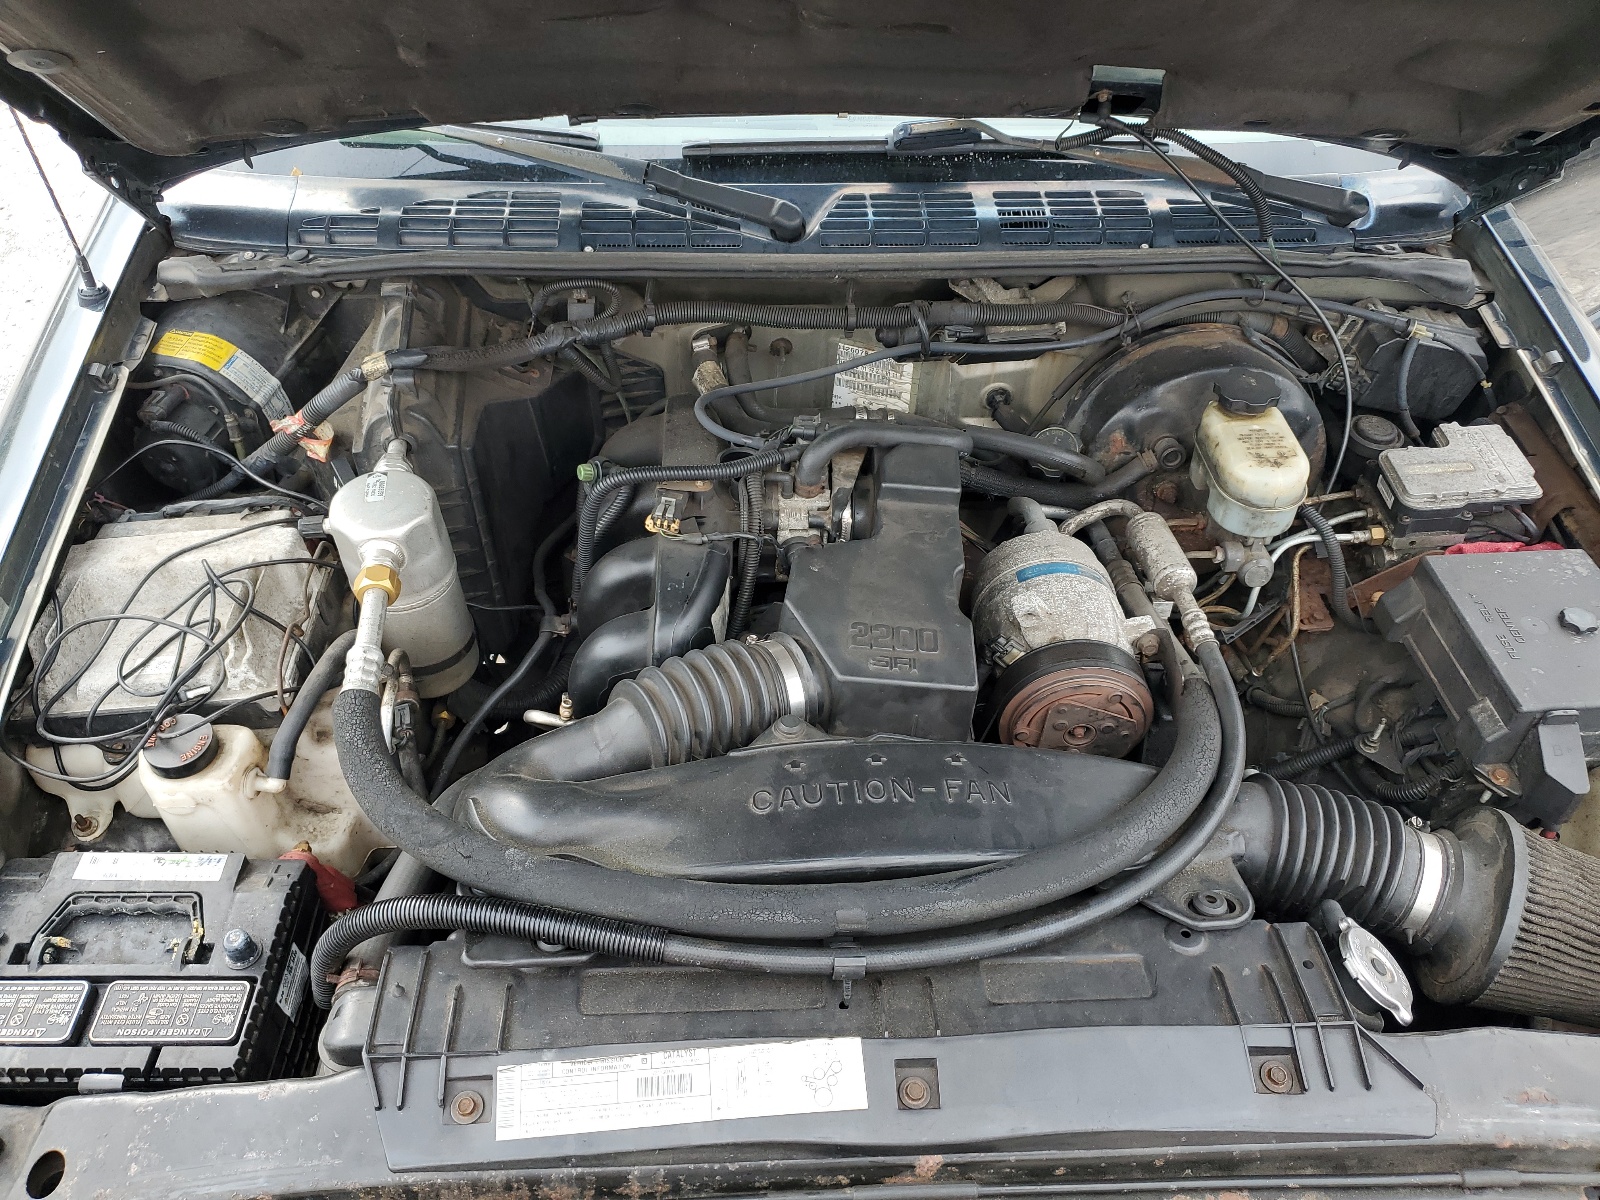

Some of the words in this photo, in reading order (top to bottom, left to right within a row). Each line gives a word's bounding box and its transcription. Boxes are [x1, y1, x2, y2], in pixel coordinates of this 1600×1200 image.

[1495, 607, 1526, 644] CENTER
[849, 621, 939, 654] 2200
[1496, 634, 1521, 660] FUSE
[868, 655, 919, 675] SFI
[179, 734, 208, 762] ENGINE
[116, 1027, 201, 1037] DANGER/POISON
[663, 1048, 697, 1060] CATALYST
[561, 1065, 589, 1075] CONTROL
[590, 1063, 632, 1073] INFORMATION
